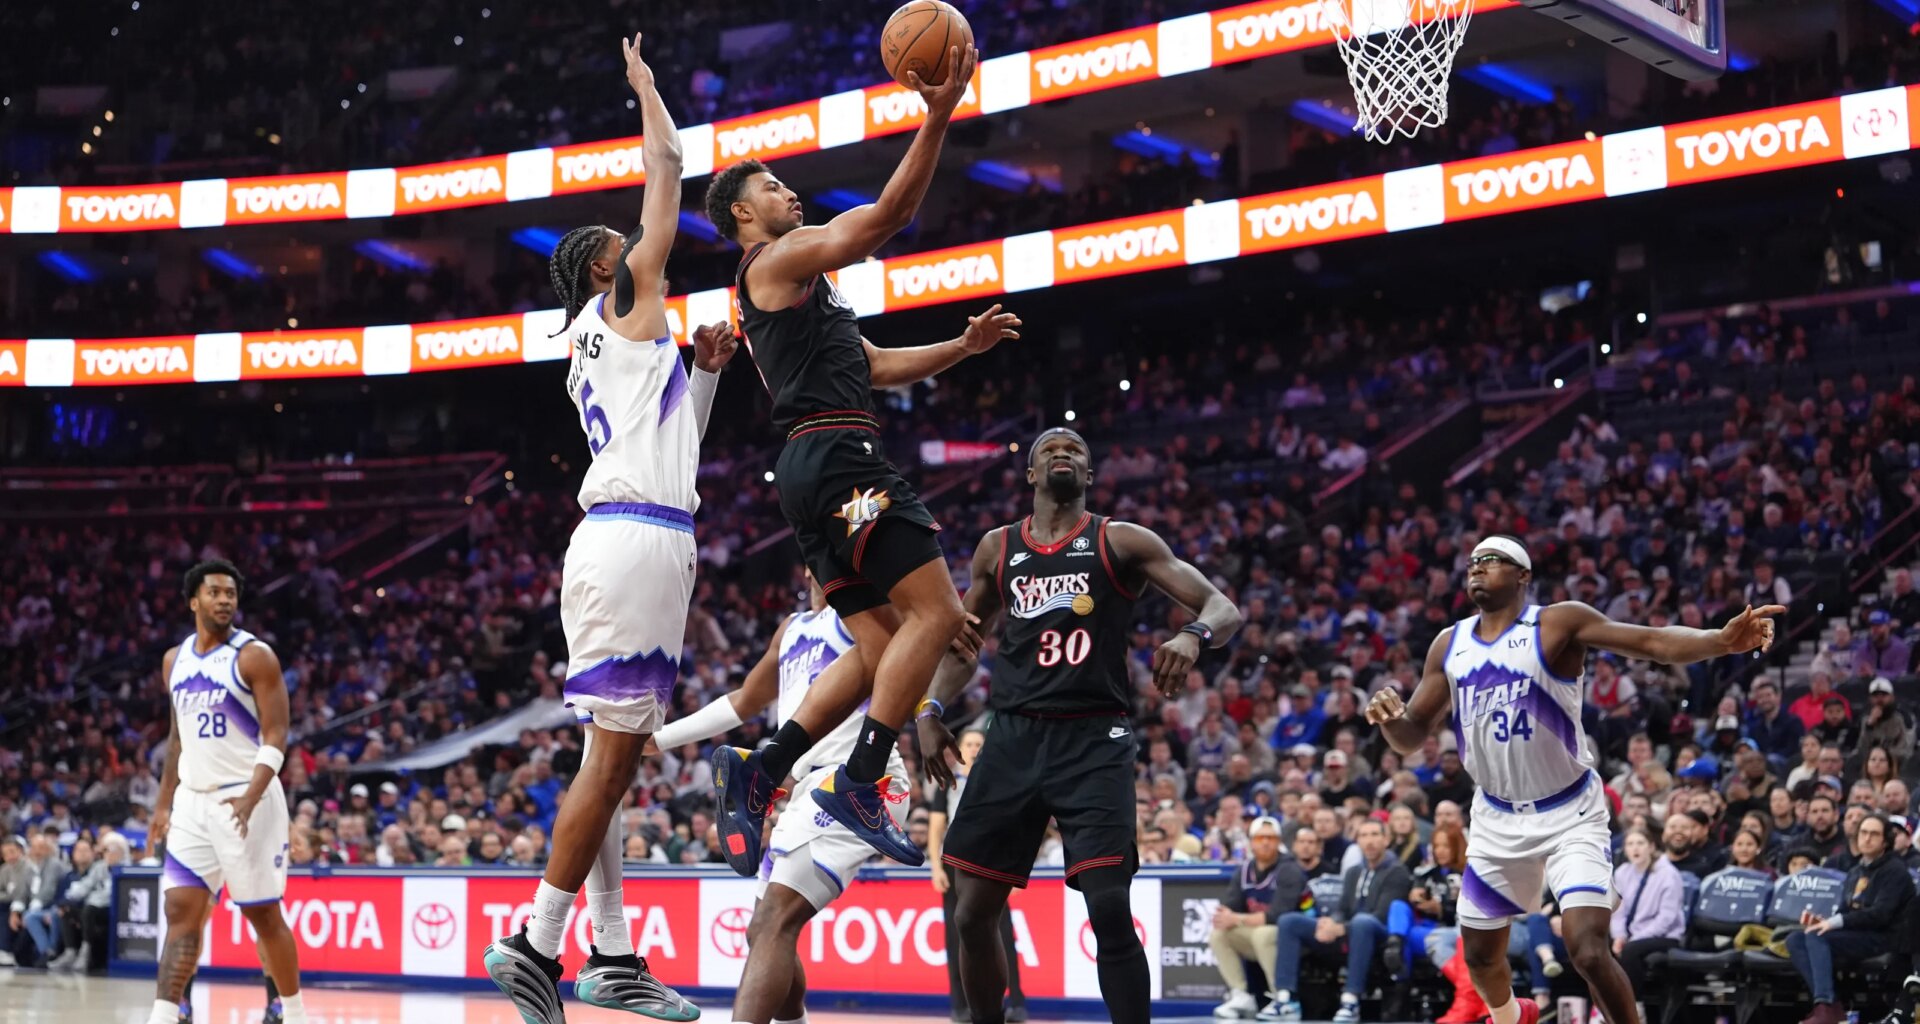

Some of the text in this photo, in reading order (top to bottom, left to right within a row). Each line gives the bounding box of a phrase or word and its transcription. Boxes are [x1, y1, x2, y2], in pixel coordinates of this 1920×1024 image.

[1217, 0, 1346, 49] TOYOTA
[1035, 40, 1152, 88] TOYOTA
[869, 81, 977, 124] TOYA
[717, 114, 815, 158] TOYOTA
[1675, 116, 1830, 169] TOYOTA
[557, 146, 645, 182] TOYOT
[1451, 154, 1594, 205] TOYOTA
[233, 183, 340, 213] TOYOTA
[401, 167, 502, 202] TOYOTA
[67, 194, 174, 222] TOYOTA
[1246, 191, 1377, 240] TOYOTA
[1059, 225, 1179, 269] TOYOTA
[888, 254, 998, 298] TOYOTA
[81, 347, 188, 375] TOYOTA
[247, 339, 357, 368] TOYOTA
[416, 326, 518, 360] TOYOTA
[581, 377, 612, 457] 5
[1037, 628, 1091, 667] 30
[1508, 638, 1529, 649] LVT
[173, 687, 229, 716] UTAH
[1458, 677, 1534, 728] UTAH
[197, 712, 227, 738] 28
[1492, 709, 1533, 743] 34
[1715, 875, 1745, 892] NJM
[1790, 874, 1818, 891] NJM
[809, 906, 1040, 967] TOYOA
